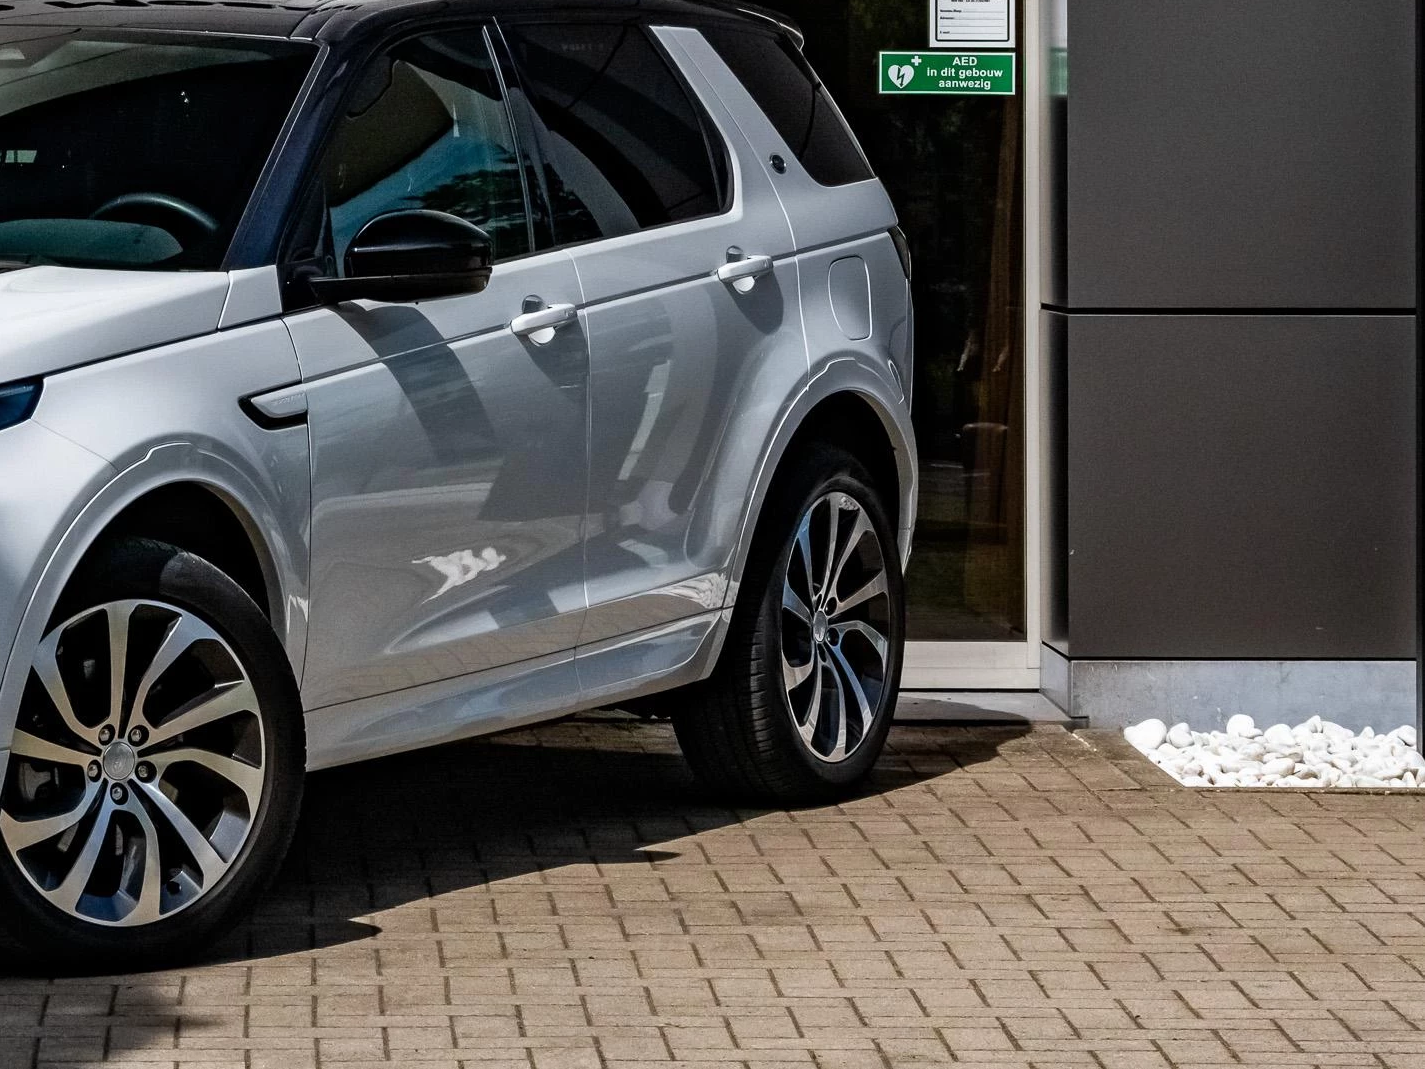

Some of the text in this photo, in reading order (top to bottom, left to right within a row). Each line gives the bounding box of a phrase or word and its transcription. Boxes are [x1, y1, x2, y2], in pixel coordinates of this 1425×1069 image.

[952, 56, 978, 66] AED
[927, 67, 1003, 79] in dit gebouw
[938, 78, 991, 90] aanwezig
